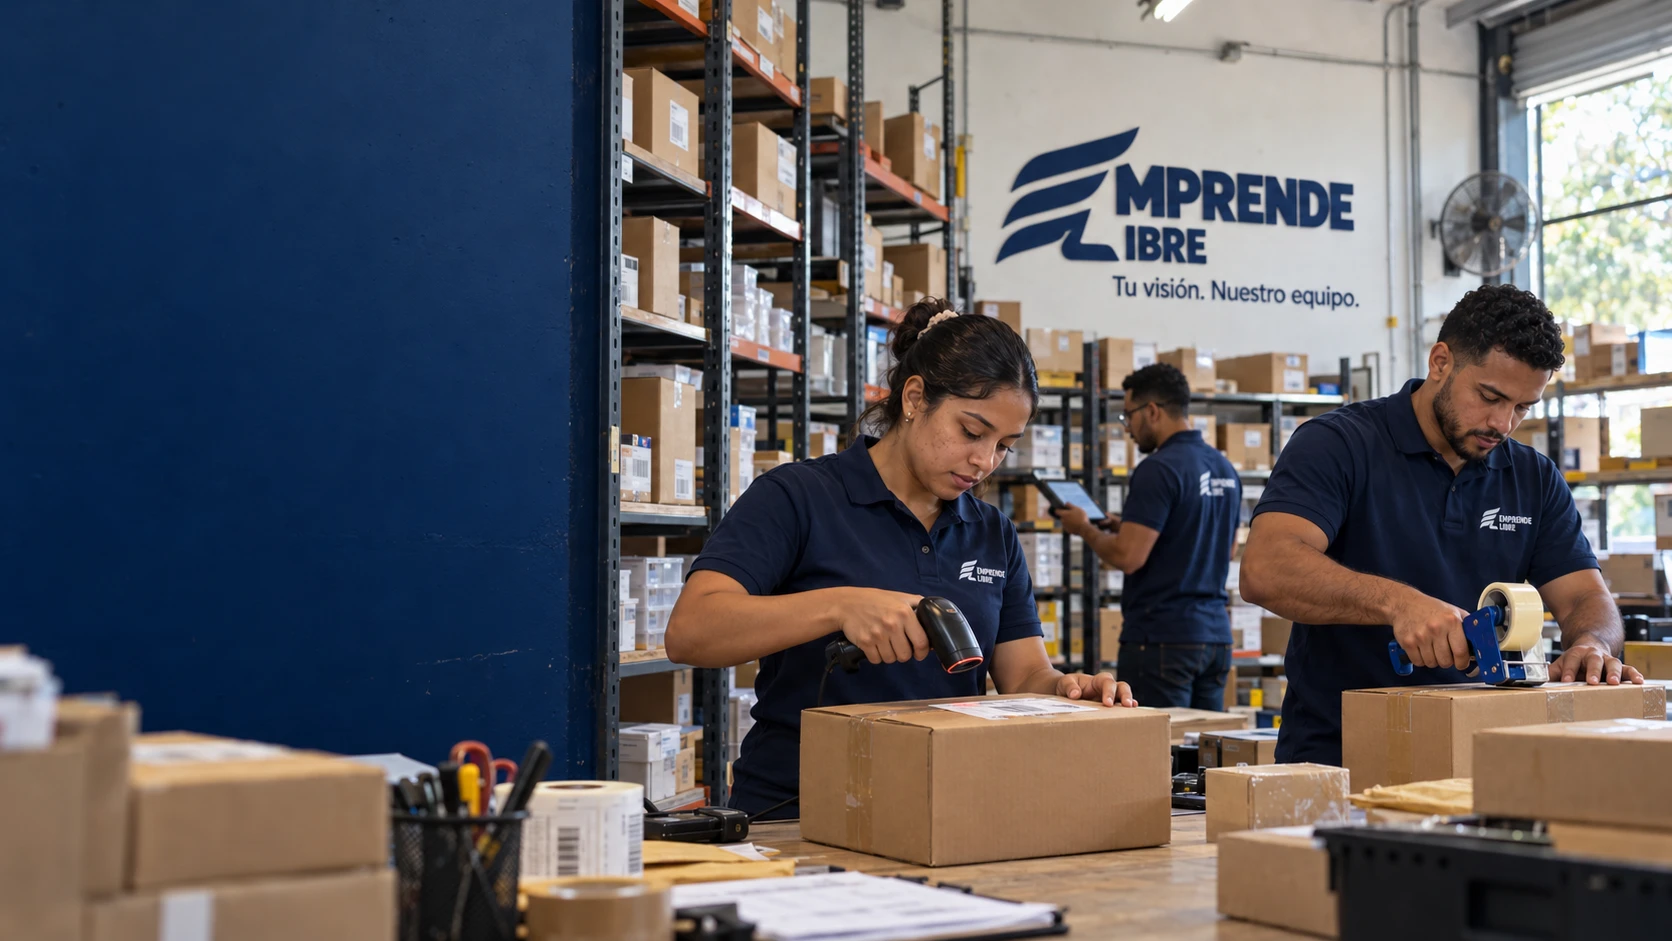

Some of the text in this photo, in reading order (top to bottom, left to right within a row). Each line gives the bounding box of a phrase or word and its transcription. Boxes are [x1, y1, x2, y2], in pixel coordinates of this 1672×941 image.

[1112, 275, 1360, 311] Tu visión. Nuestro equipo.
